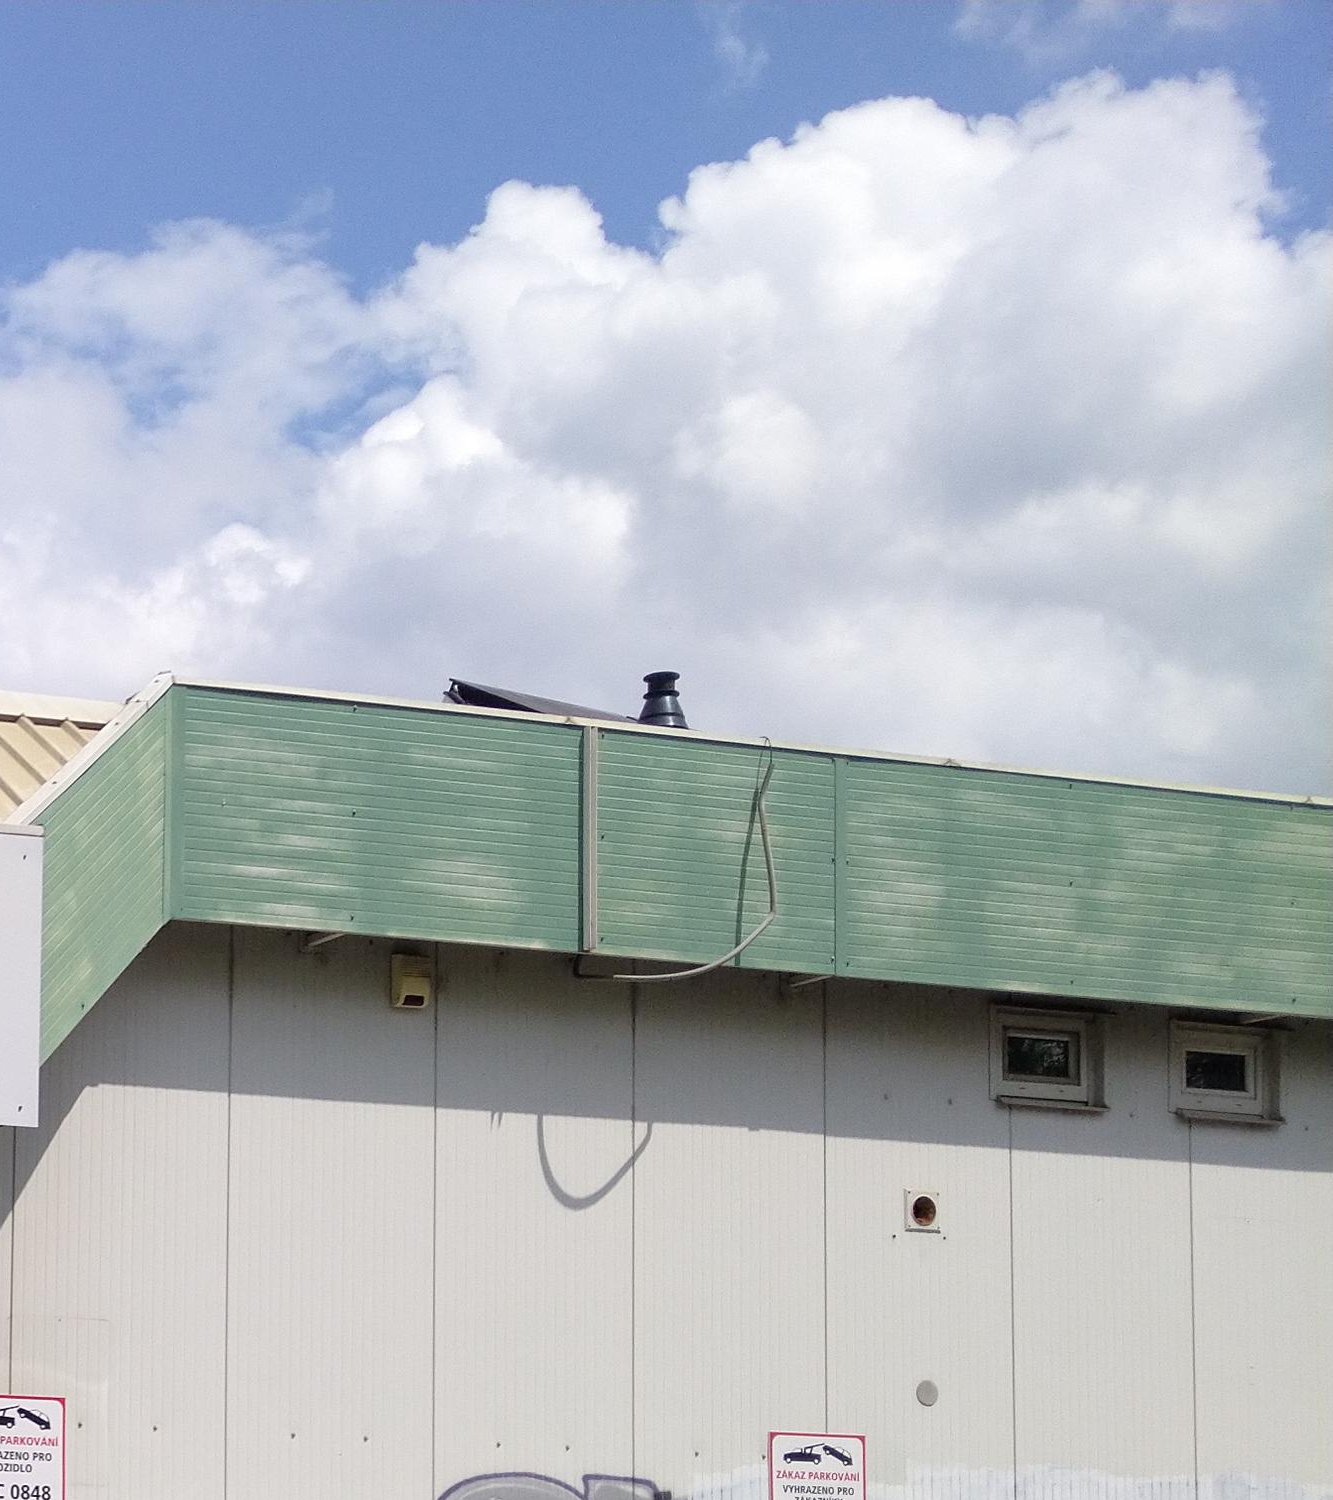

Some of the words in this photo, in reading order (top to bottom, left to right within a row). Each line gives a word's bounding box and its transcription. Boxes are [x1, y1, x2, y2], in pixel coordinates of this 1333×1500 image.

[0, 1435, 58, 1446] PARKOVÁNÍ
[32, 1452, 52, 1461] PRO
[776, 1470, 805, 1479] ZÁKAZ
[808, 1471, 860, 1481] PARKOVÁNÍ
[10, 1484, 52, 1500] 0848
[782, 1485, 834, 1495] VYHRAZENO
[837, 1487, 854, 1495] PRO
